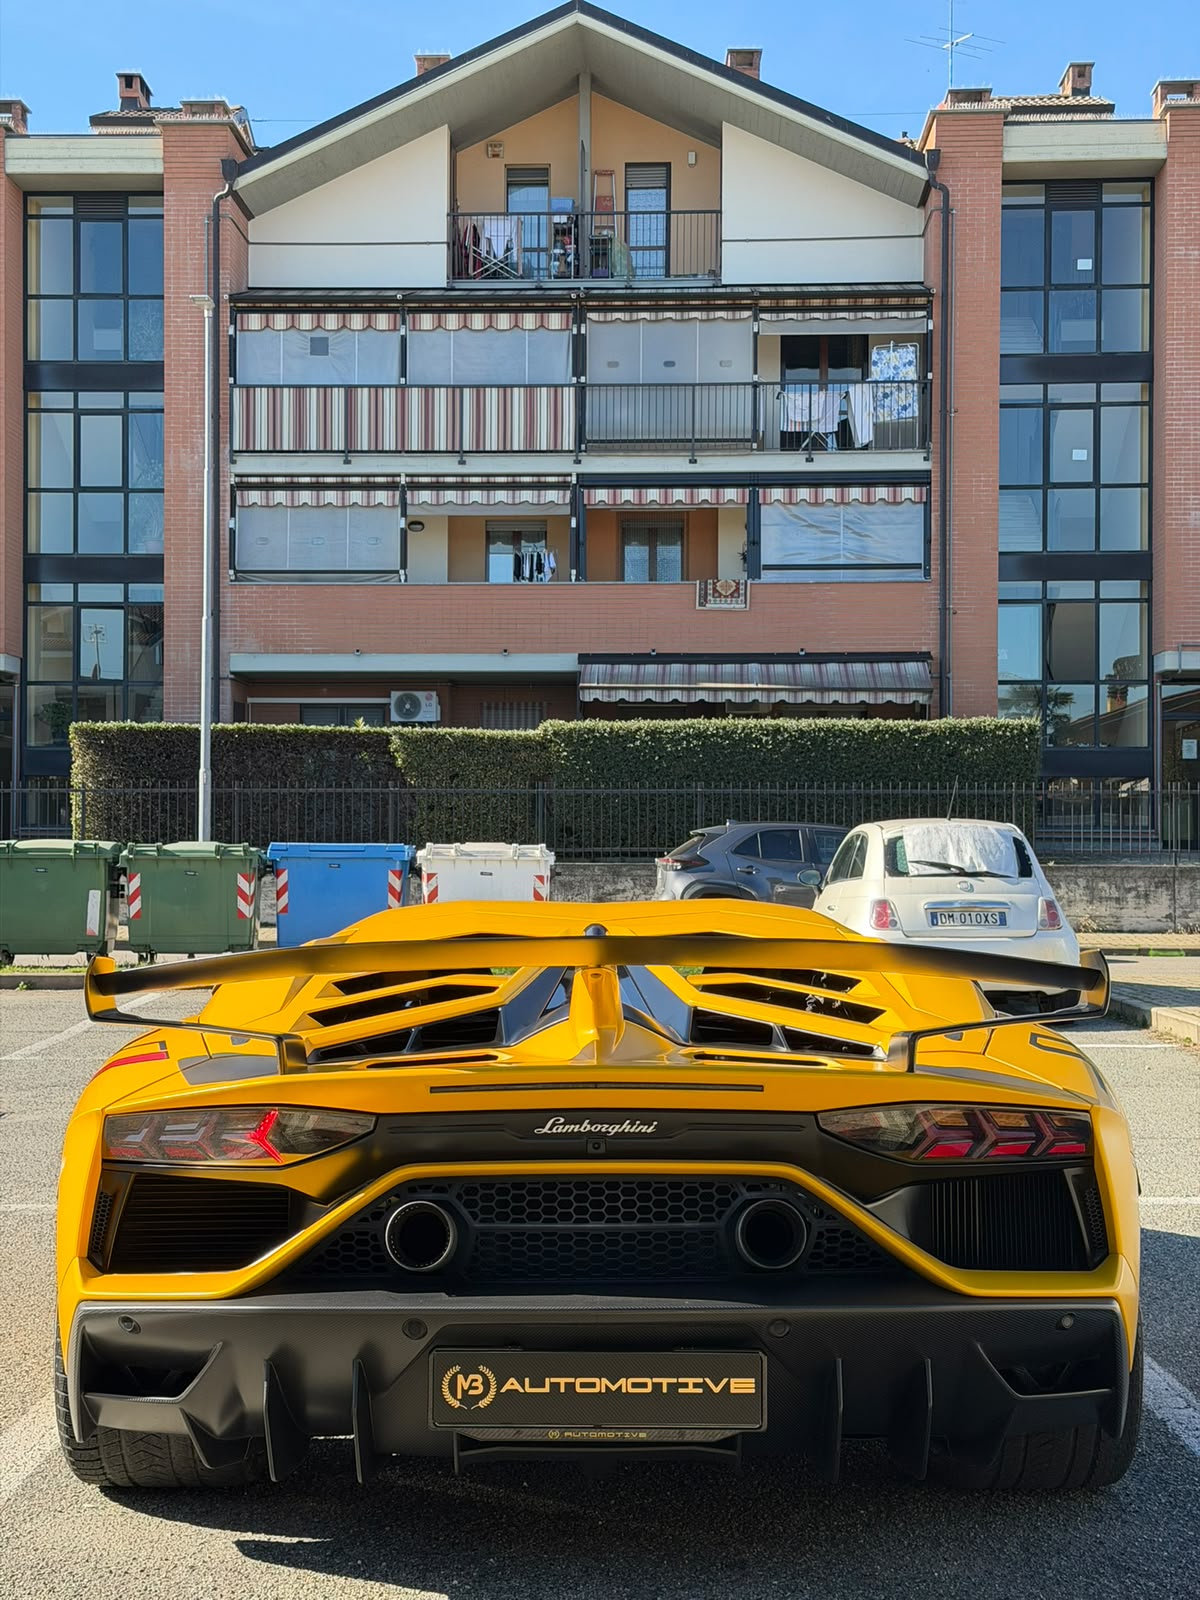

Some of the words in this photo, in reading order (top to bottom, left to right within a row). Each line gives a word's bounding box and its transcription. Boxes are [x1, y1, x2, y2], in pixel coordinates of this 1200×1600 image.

[939, 913, 955, 925] DM
[959, 913, 998, 925] 010XS
[534, 1116, 658, 1136] Lamborghini
[500, 1377, 756, 1394] AUTOMOTIVE
